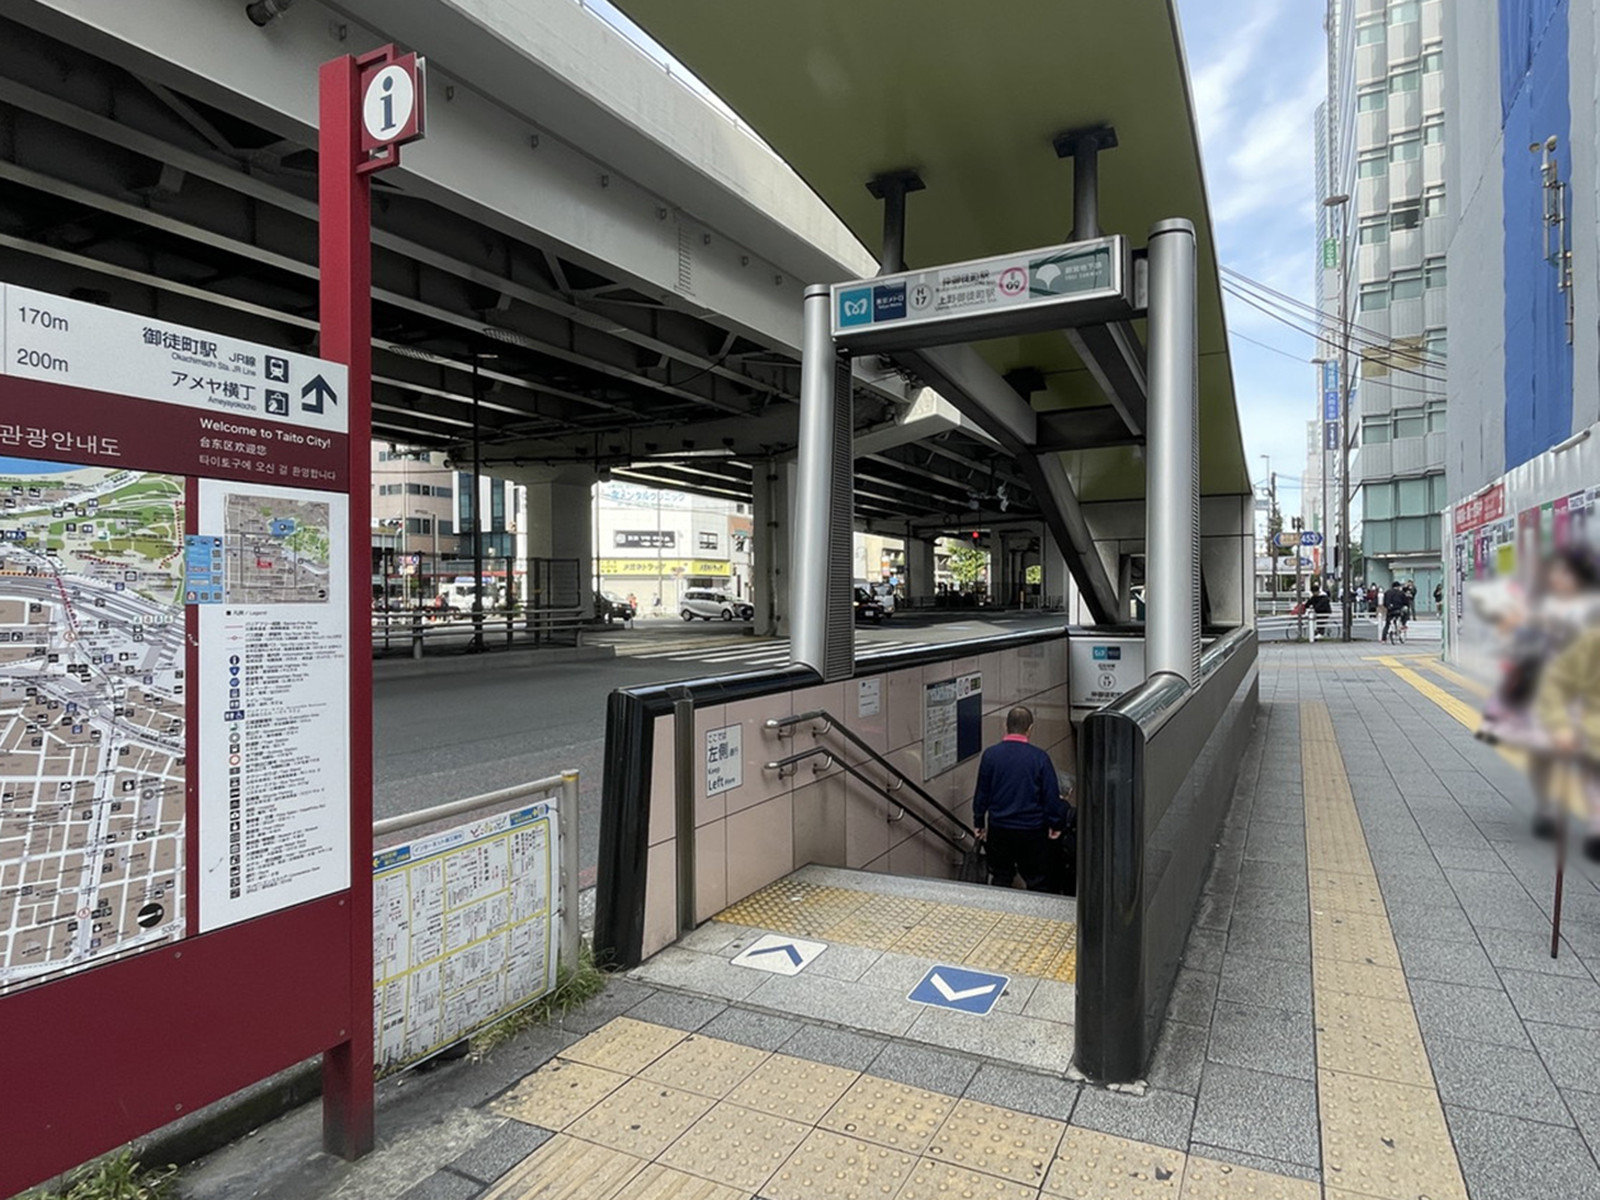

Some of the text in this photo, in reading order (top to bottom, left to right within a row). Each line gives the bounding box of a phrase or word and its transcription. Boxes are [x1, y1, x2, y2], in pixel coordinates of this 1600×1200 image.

[915, 295, 927, 306] 17
[18, 305, 70, 332] 170m
[16, 347, 70, 373] 200m
[142, 326, 257, 367] 御徒町駅 JR線
[171, 370, 257, 401] アメヤ横丁
[0, 424, 122, 457] 관광안내도
[199, 417, 332, 450] Welcome to Taito City!
[708, 775, 724, 791] Left
